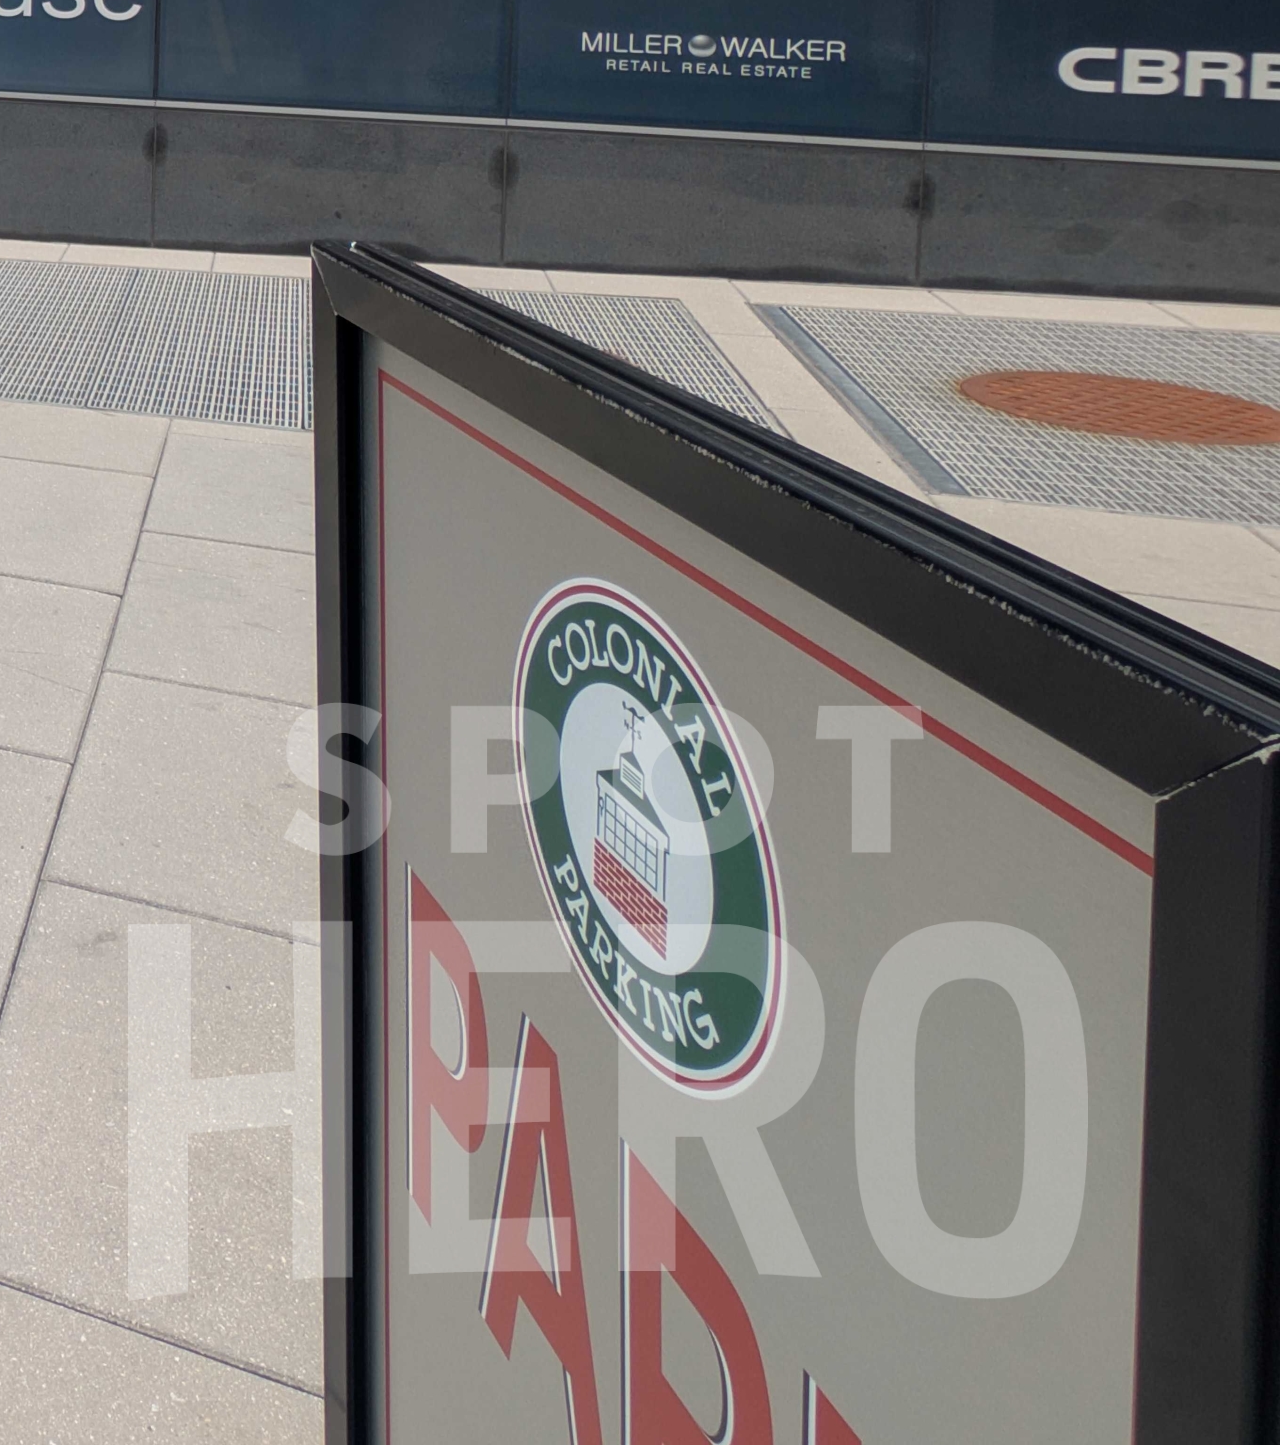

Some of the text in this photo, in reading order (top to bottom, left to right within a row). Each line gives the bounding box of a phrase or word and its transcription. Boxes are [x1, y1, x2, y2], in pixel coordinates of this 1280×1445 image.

[581, 32, 846, 61] MILLER WALKER
[606, 59, 812, 79] RETAIL REAL ESTATE
[547, 620, 733, 817] COLONIAL
[553, 853, 720, 1051] PARKING
[406, 862, 864, 1445] PAR
